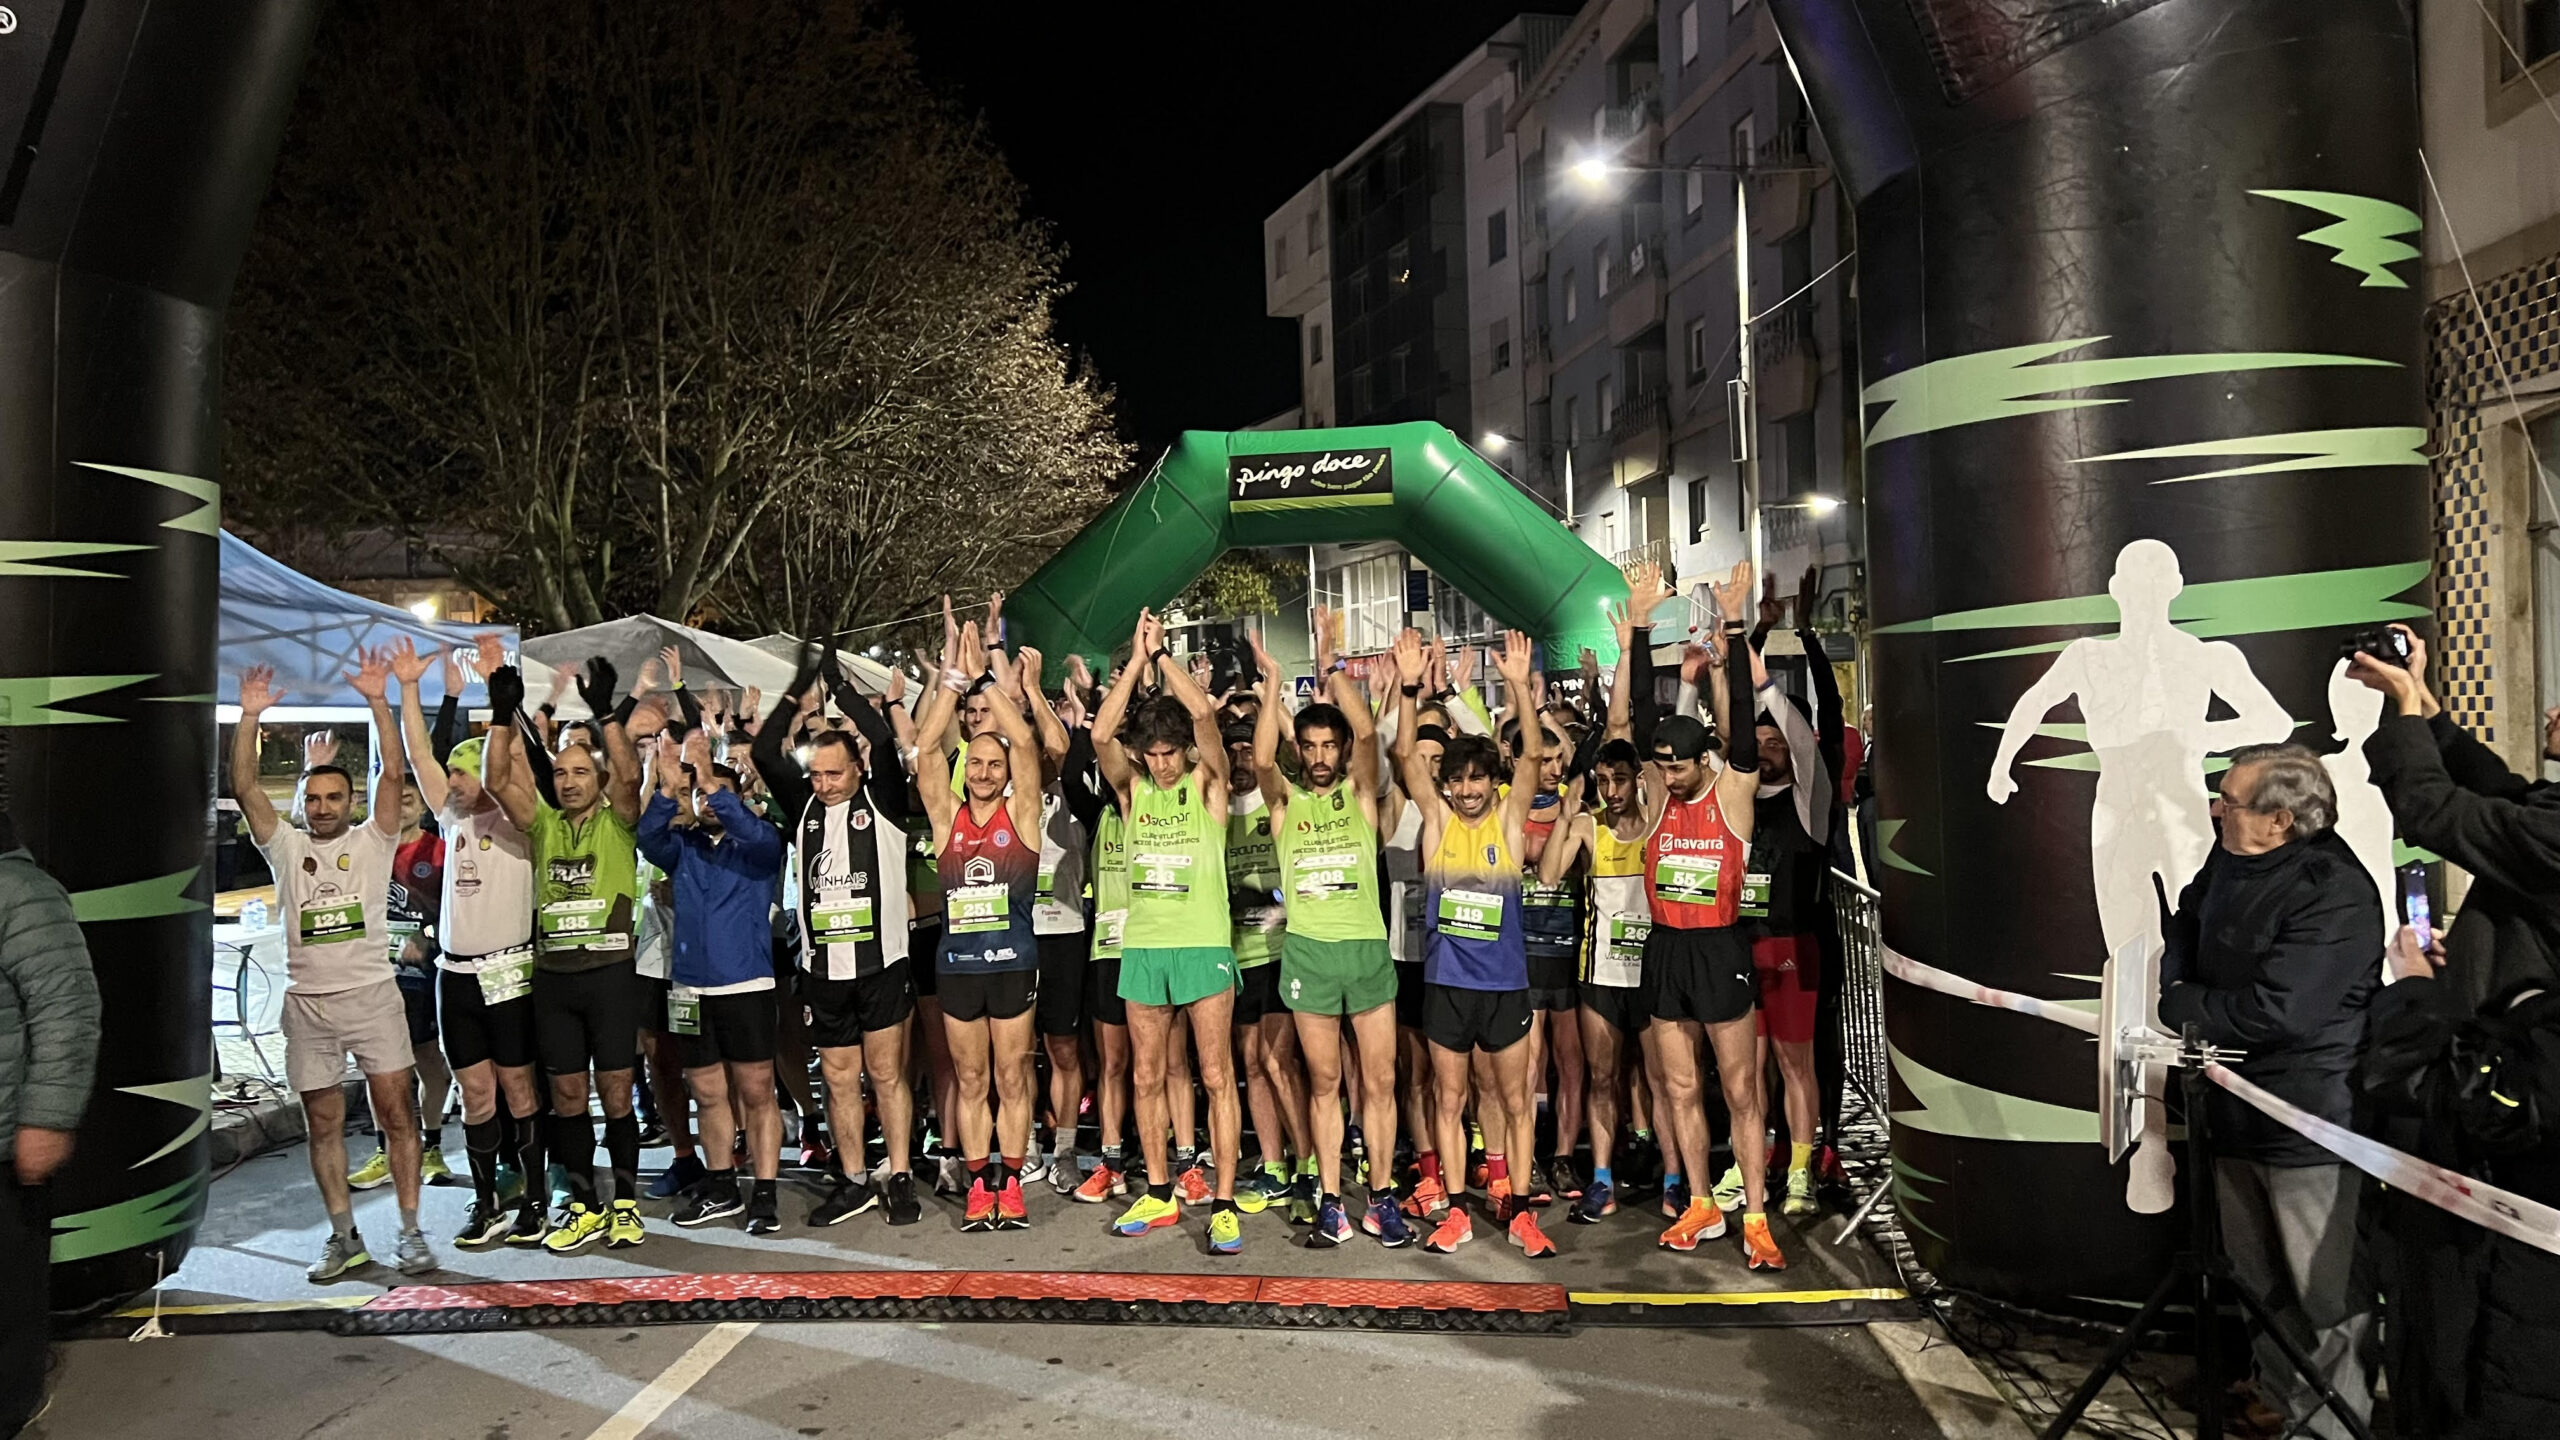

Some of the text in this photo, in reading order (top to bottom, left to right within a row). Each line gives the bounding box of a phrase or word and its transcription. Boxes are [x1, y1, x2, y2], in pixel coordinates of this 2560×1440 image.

[1236, 452, 1371, 496] pingo doce
[1673, 838, 1724, 851] navarra
[812, 872, 868, 889] VINHAIS
[1672, 871, 1697, 887] 55
[963, 902, 994, 917] 251
[1454, 905, 1484, 923] 119
[313, 910, 348, 929] 124
[556, 915, 590, 931] 135
[828, 913, 853, 929] 98
[1624, 926, 1651, 941] 26
